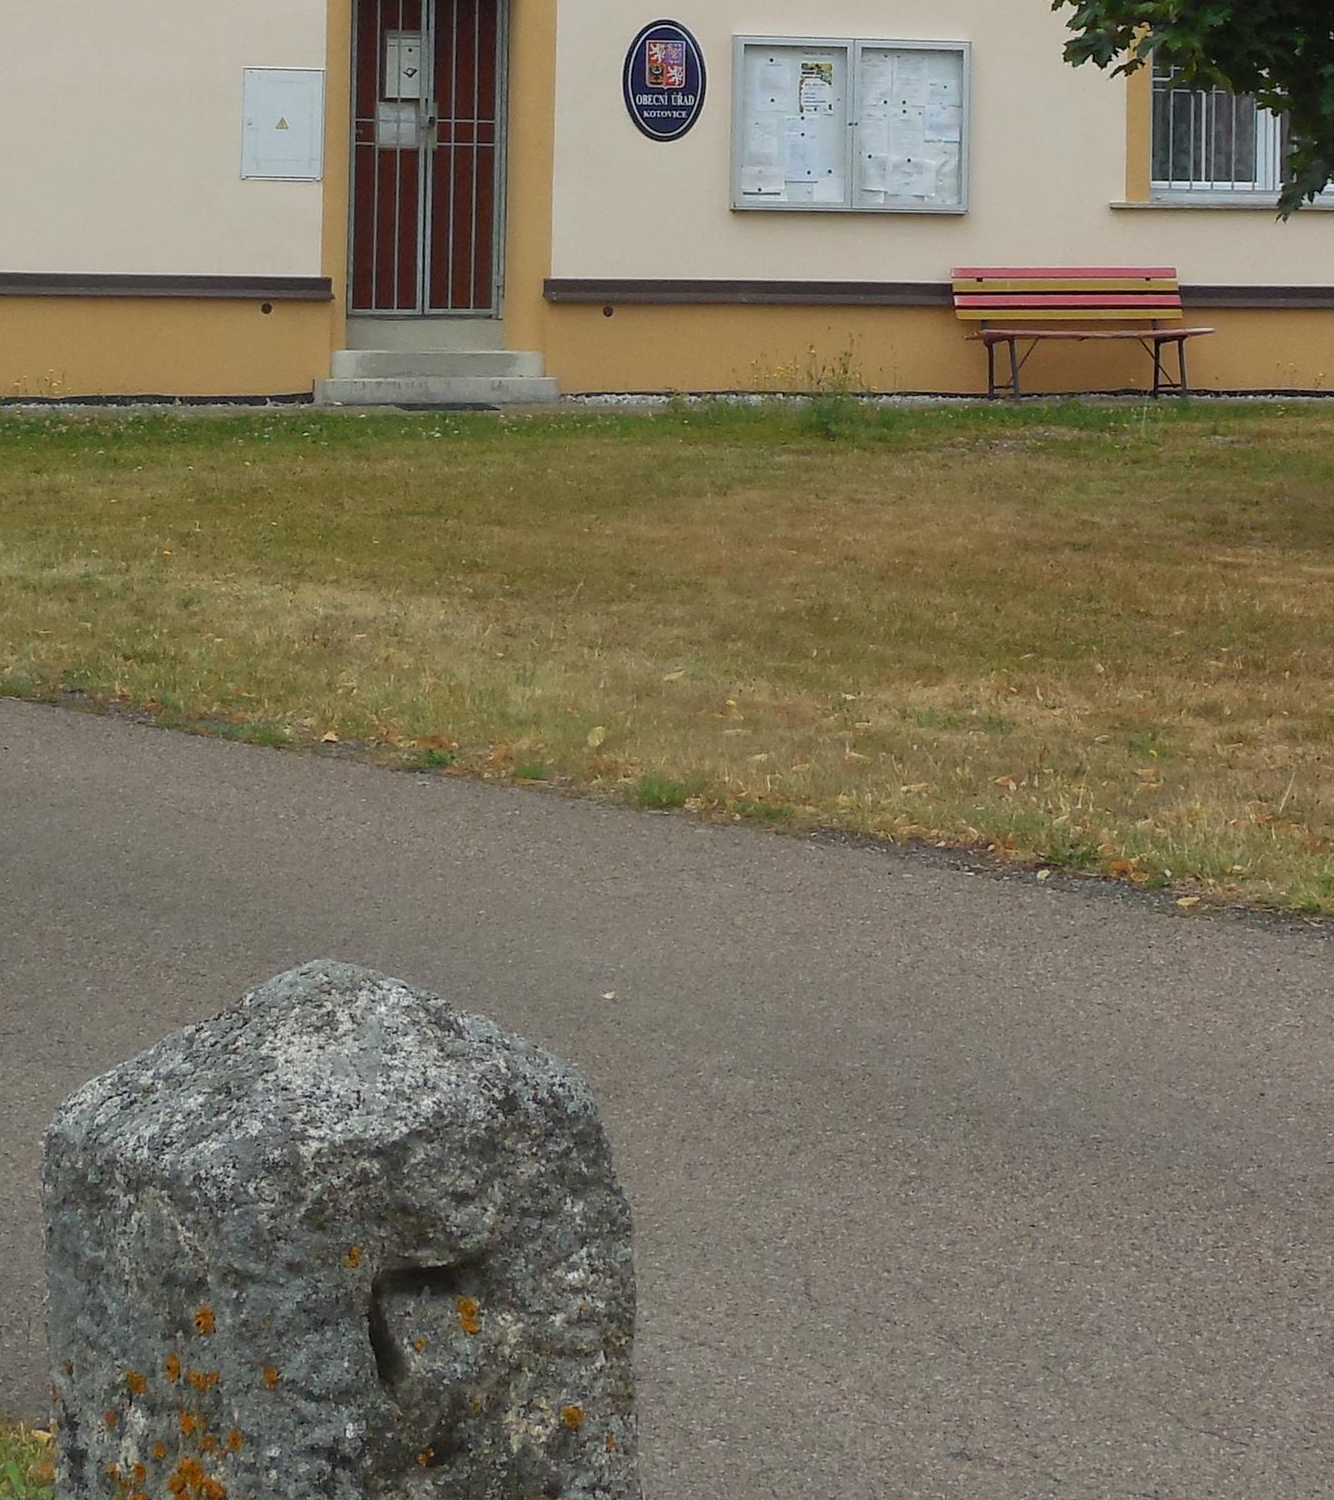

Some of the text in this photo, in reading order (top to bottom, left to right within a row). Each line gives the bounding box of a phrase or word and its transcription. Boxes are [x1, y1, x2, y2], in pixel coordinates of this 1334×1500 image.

[635, 91, 695, 106] OBECNÍ ÚŘAD
[643, 110, 688, 118] KOTOVICE
